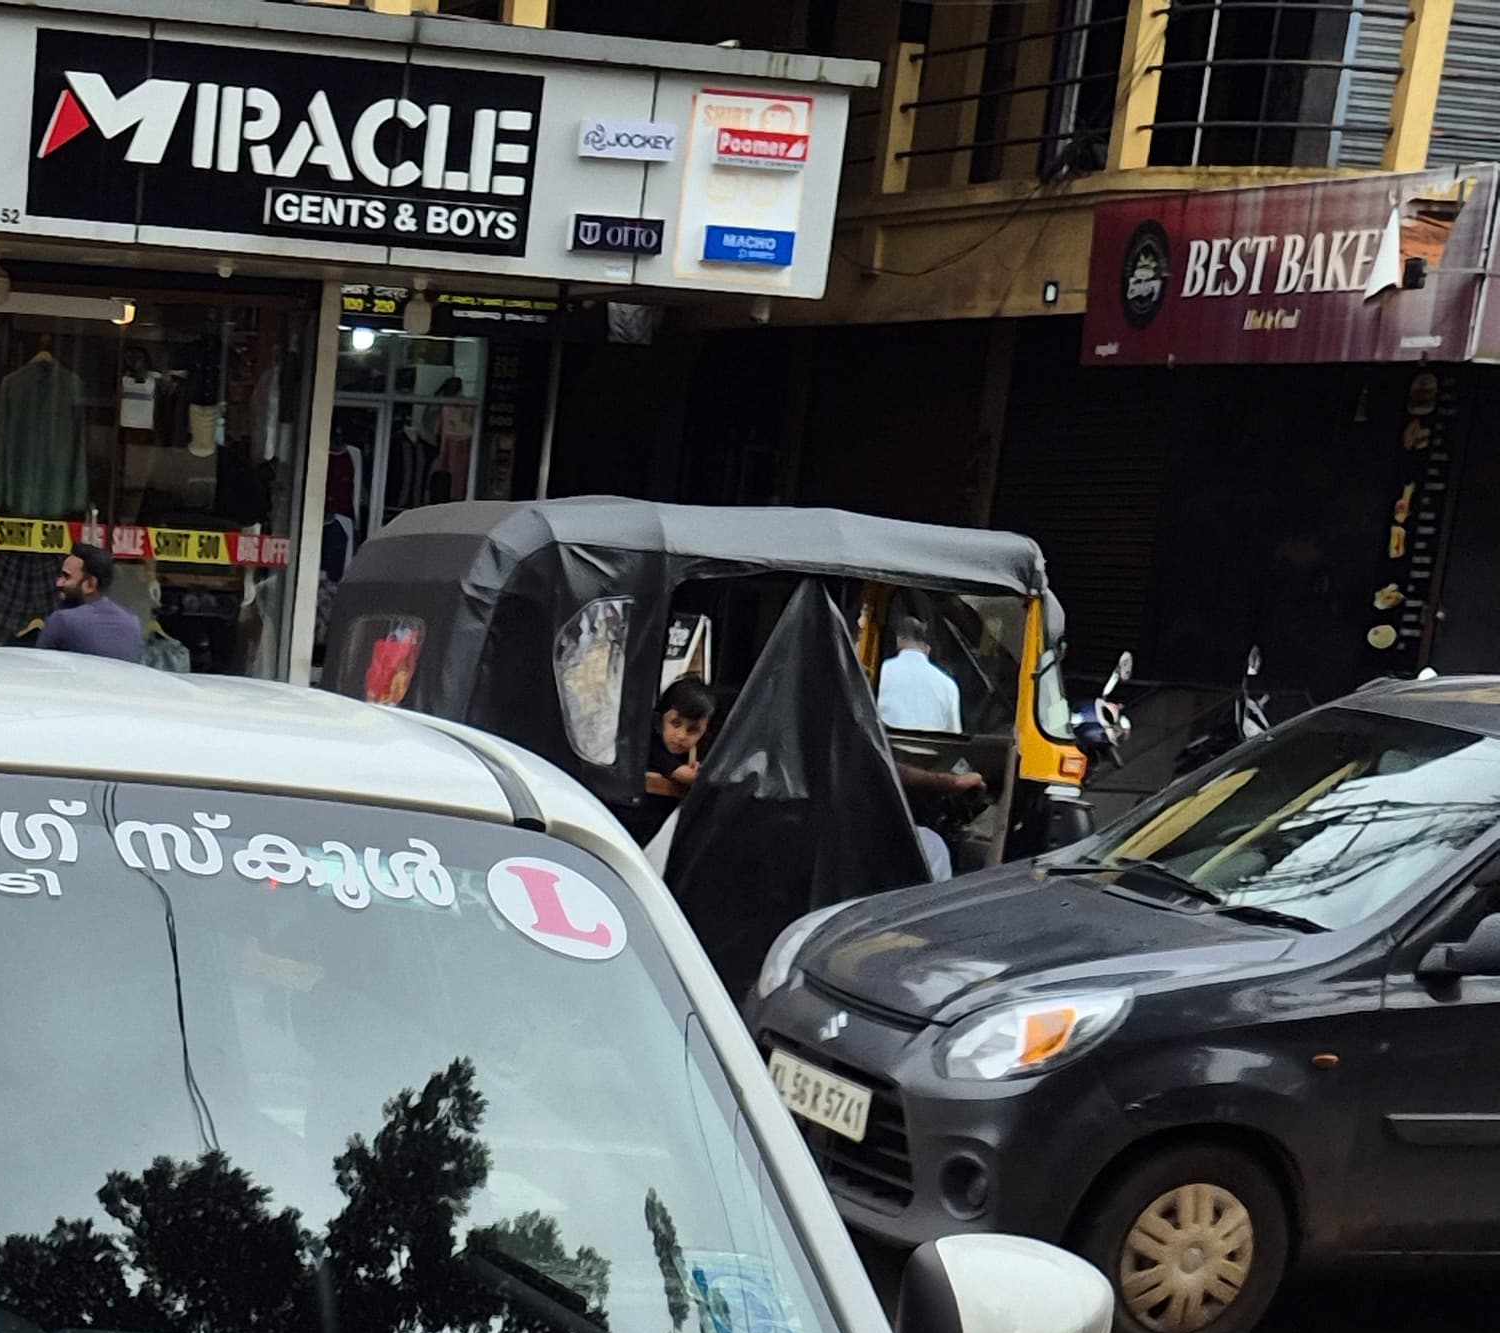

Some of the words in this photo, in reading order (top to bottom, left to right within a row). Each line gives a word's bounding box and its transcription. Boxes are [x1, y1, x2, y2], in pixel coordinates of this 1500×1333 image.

[37, 70, 533, 196] MIRACLE
[606, 133, 674, 151] JOCKEY
[719, 131, 787, 157] Poomer
[1, 208, 21, 224] 52
[274, 193, 386, 229] GENTS
[394, 203, 418, 232] &
[426, 206, 518, 240] BOYS
[723, 233, 776, 251] MACHO
[1181, 234, 1278, 299] BEST
[1275, 229, 1387, 296] BAKE
[41, 520, 66, 549] 500
[112, 526, 145, 556] SALE
[155, 530, 190, 559] SHIRT
[197, 532, 221, 560] 500
[238, 535, 260, 563] BIG
[261, 536, 290, 565] OFF
[112, 811, 457, 910] സ്കൂൾ
[505, 864, 613, 949] L
